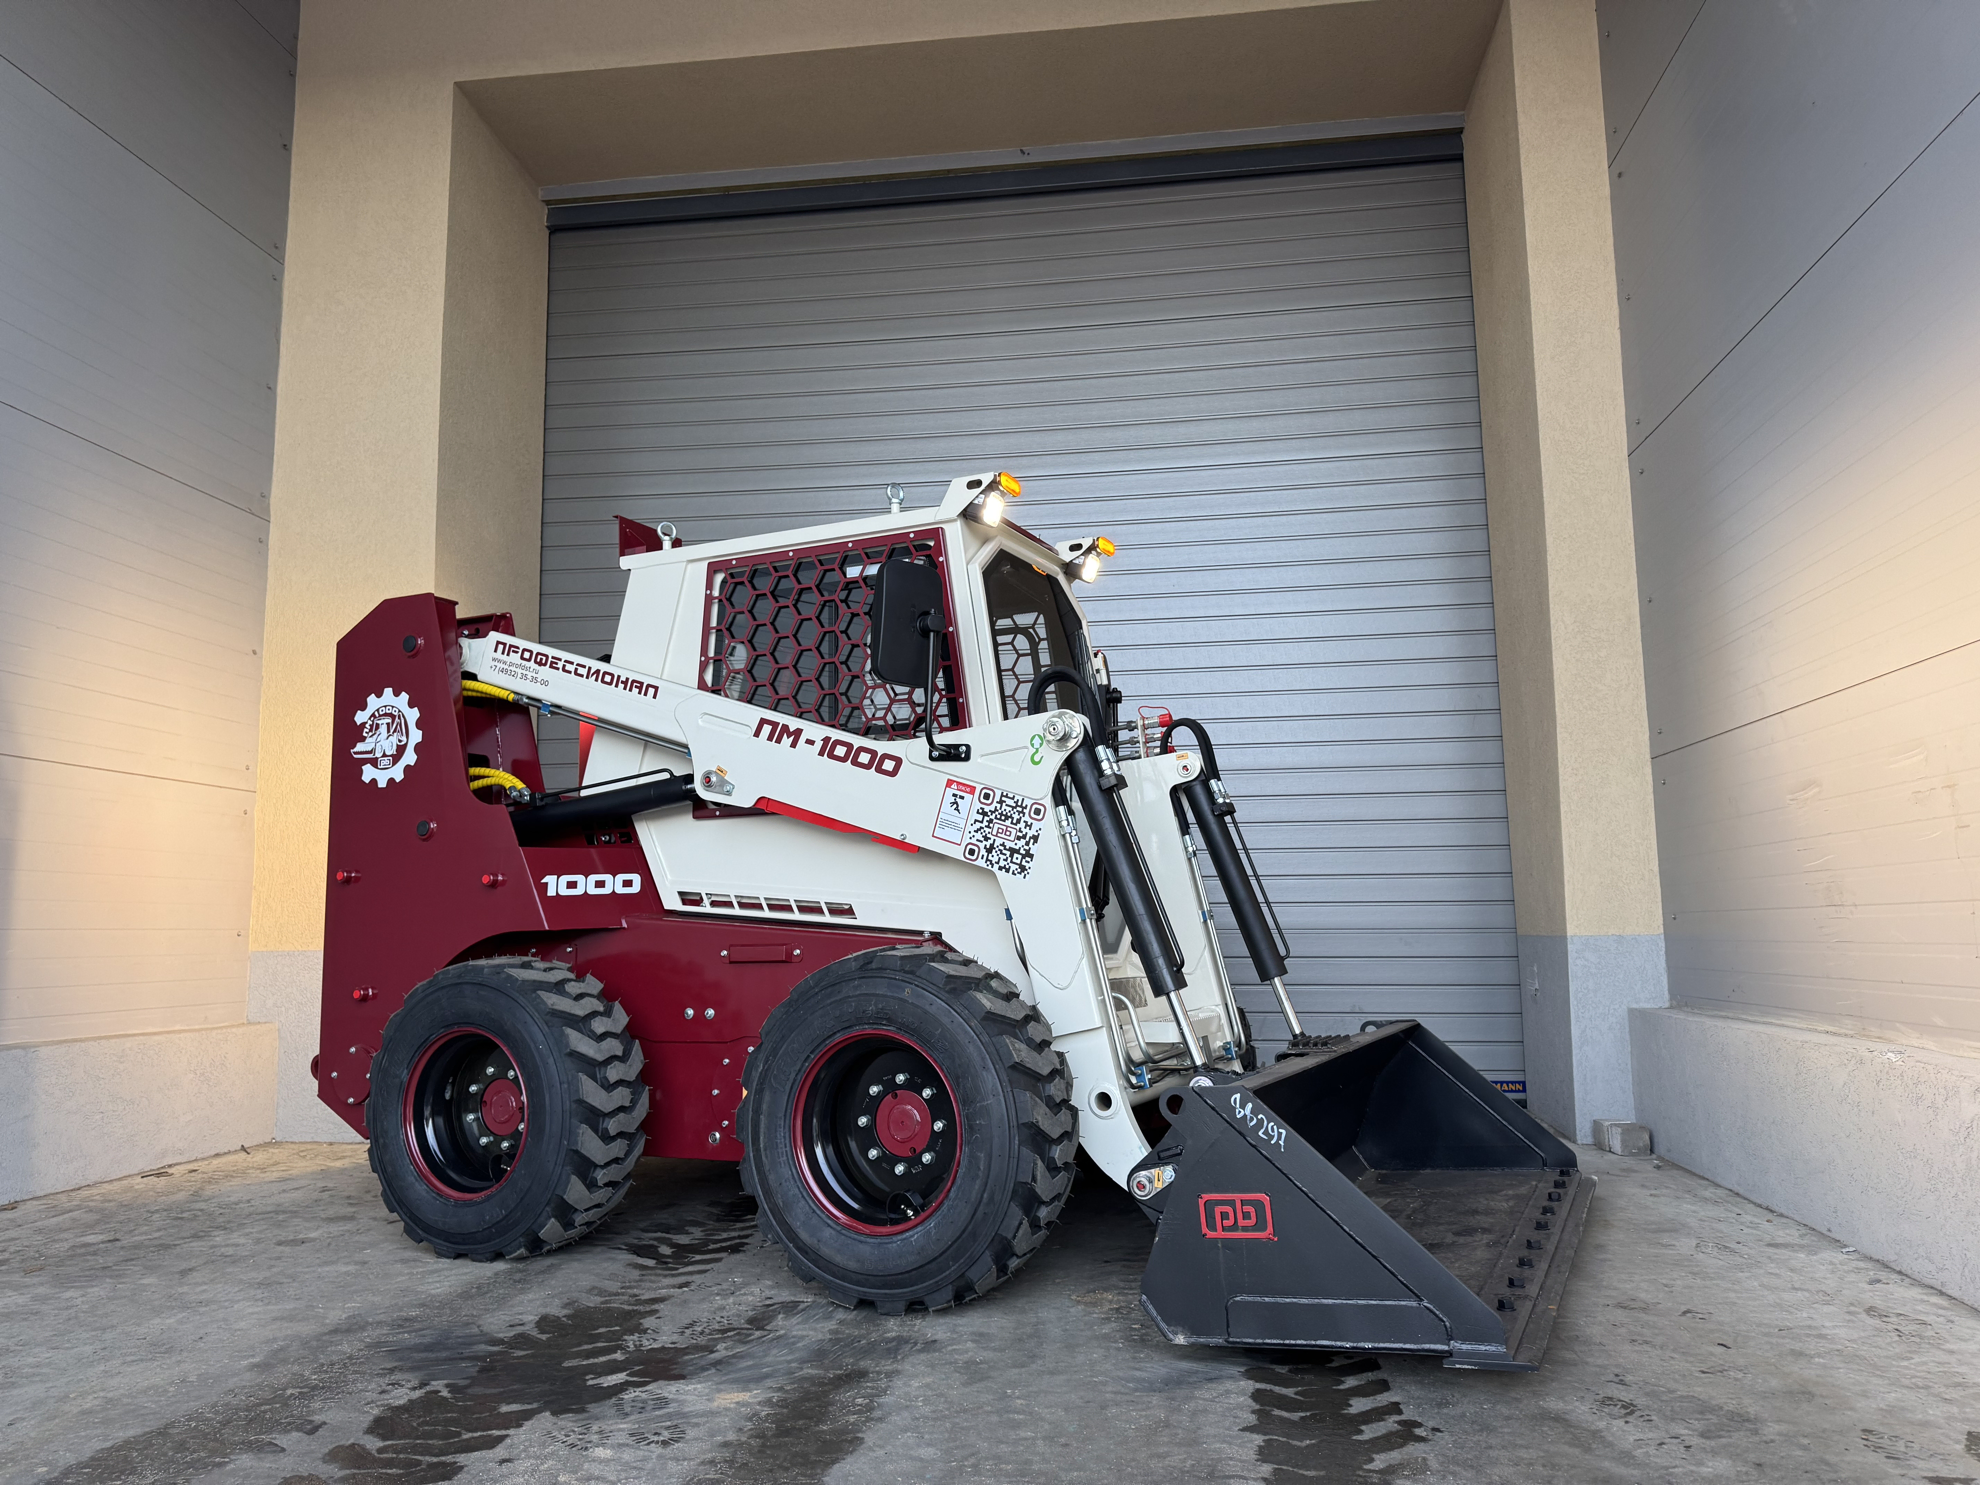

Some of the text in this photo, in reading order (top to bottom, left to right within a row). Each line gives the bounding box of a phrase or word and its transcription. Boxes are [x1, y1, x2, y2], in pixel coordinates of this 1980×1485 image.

[491, 657, 540, 675] www.profdst.ru
[497, 666, 519, 680] (4932)
[519, 672, 550, 687] 35-35-00
[540, 873, 642, 897] 1000
